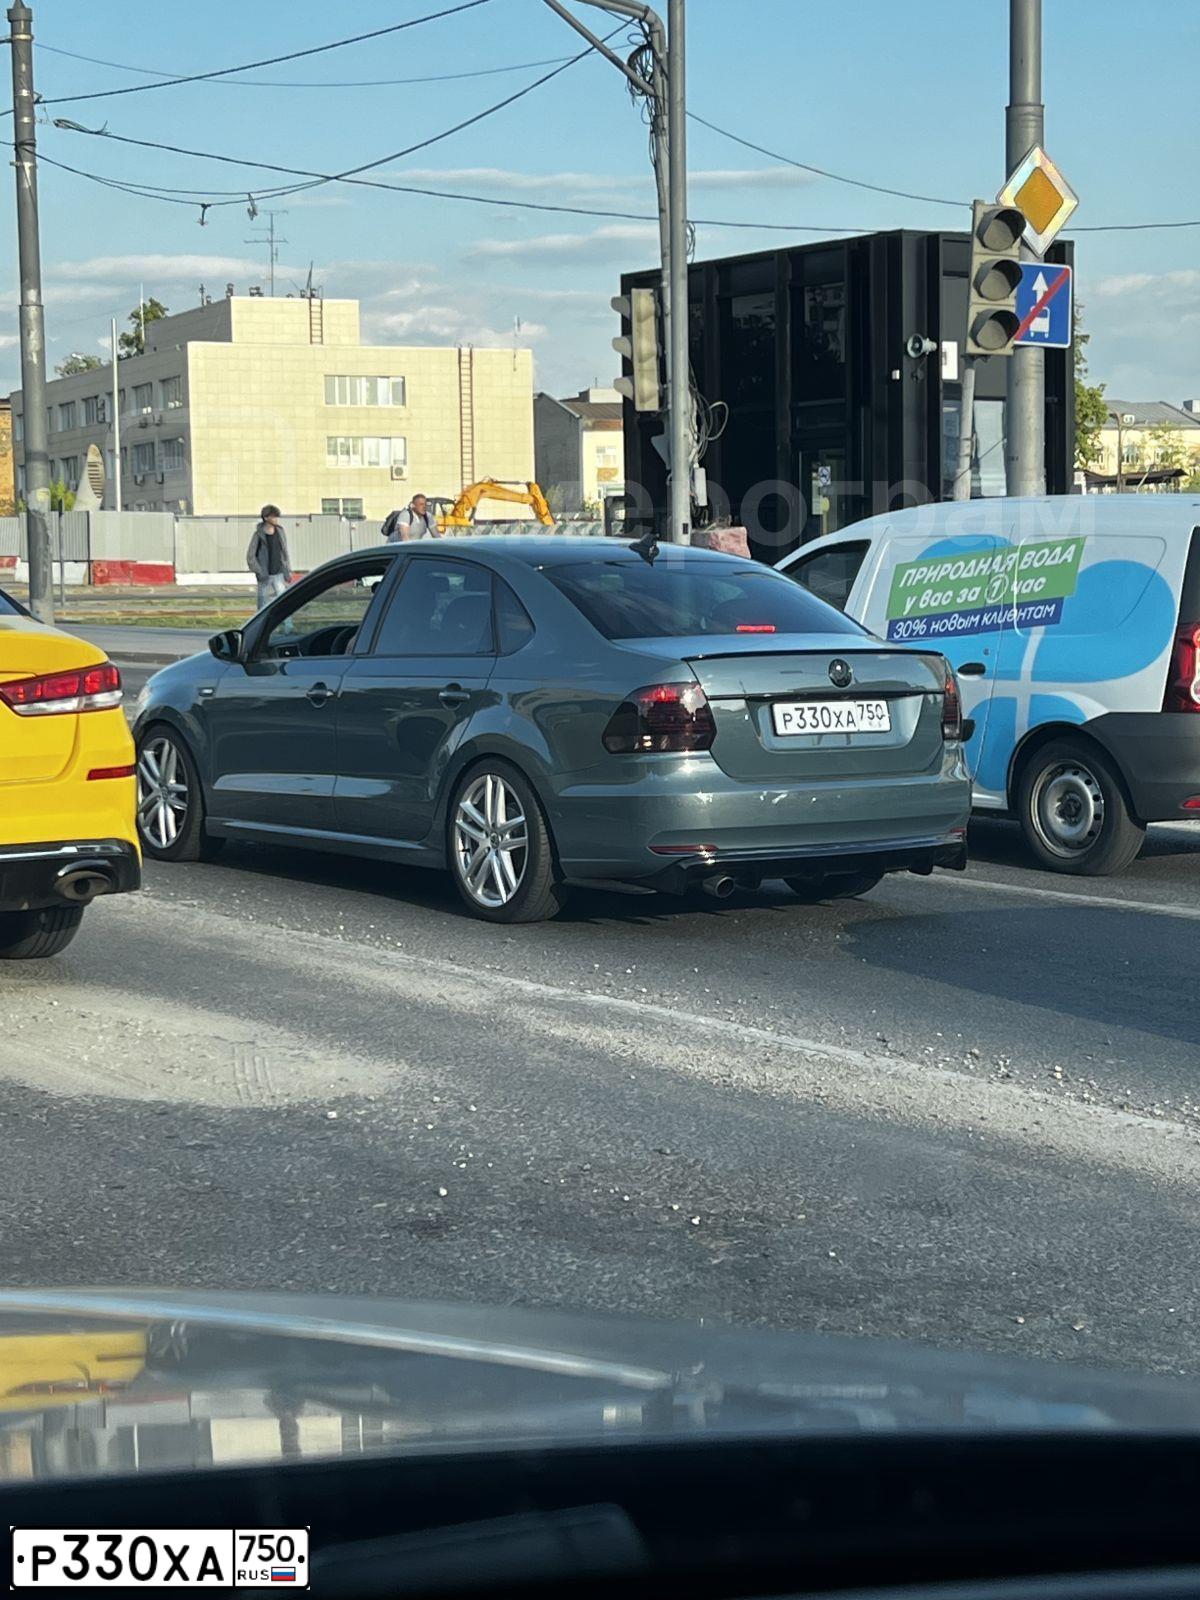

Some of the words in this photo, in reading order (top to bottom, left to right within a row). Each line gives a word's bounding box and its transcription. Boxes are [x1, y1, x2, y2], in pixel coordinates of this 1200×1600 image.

[899, 552, 1017, 588] ПРИРОДНАЯ
[1018, 544, 1076, 571] ВОДА
[903, 594, 917, 616] у
[919, 589, 954, 608] вас
[956, 586, 981, 602] за
[1011, 575, 1047, 594] час
[893, 617, 928, 639] 30%
[929, 610, 980, 634] новым
[981, 602, 1056, 627] клиентам
[783, 706, 856, 730] Р330ХА
[857, 703, 885, 720] 750
